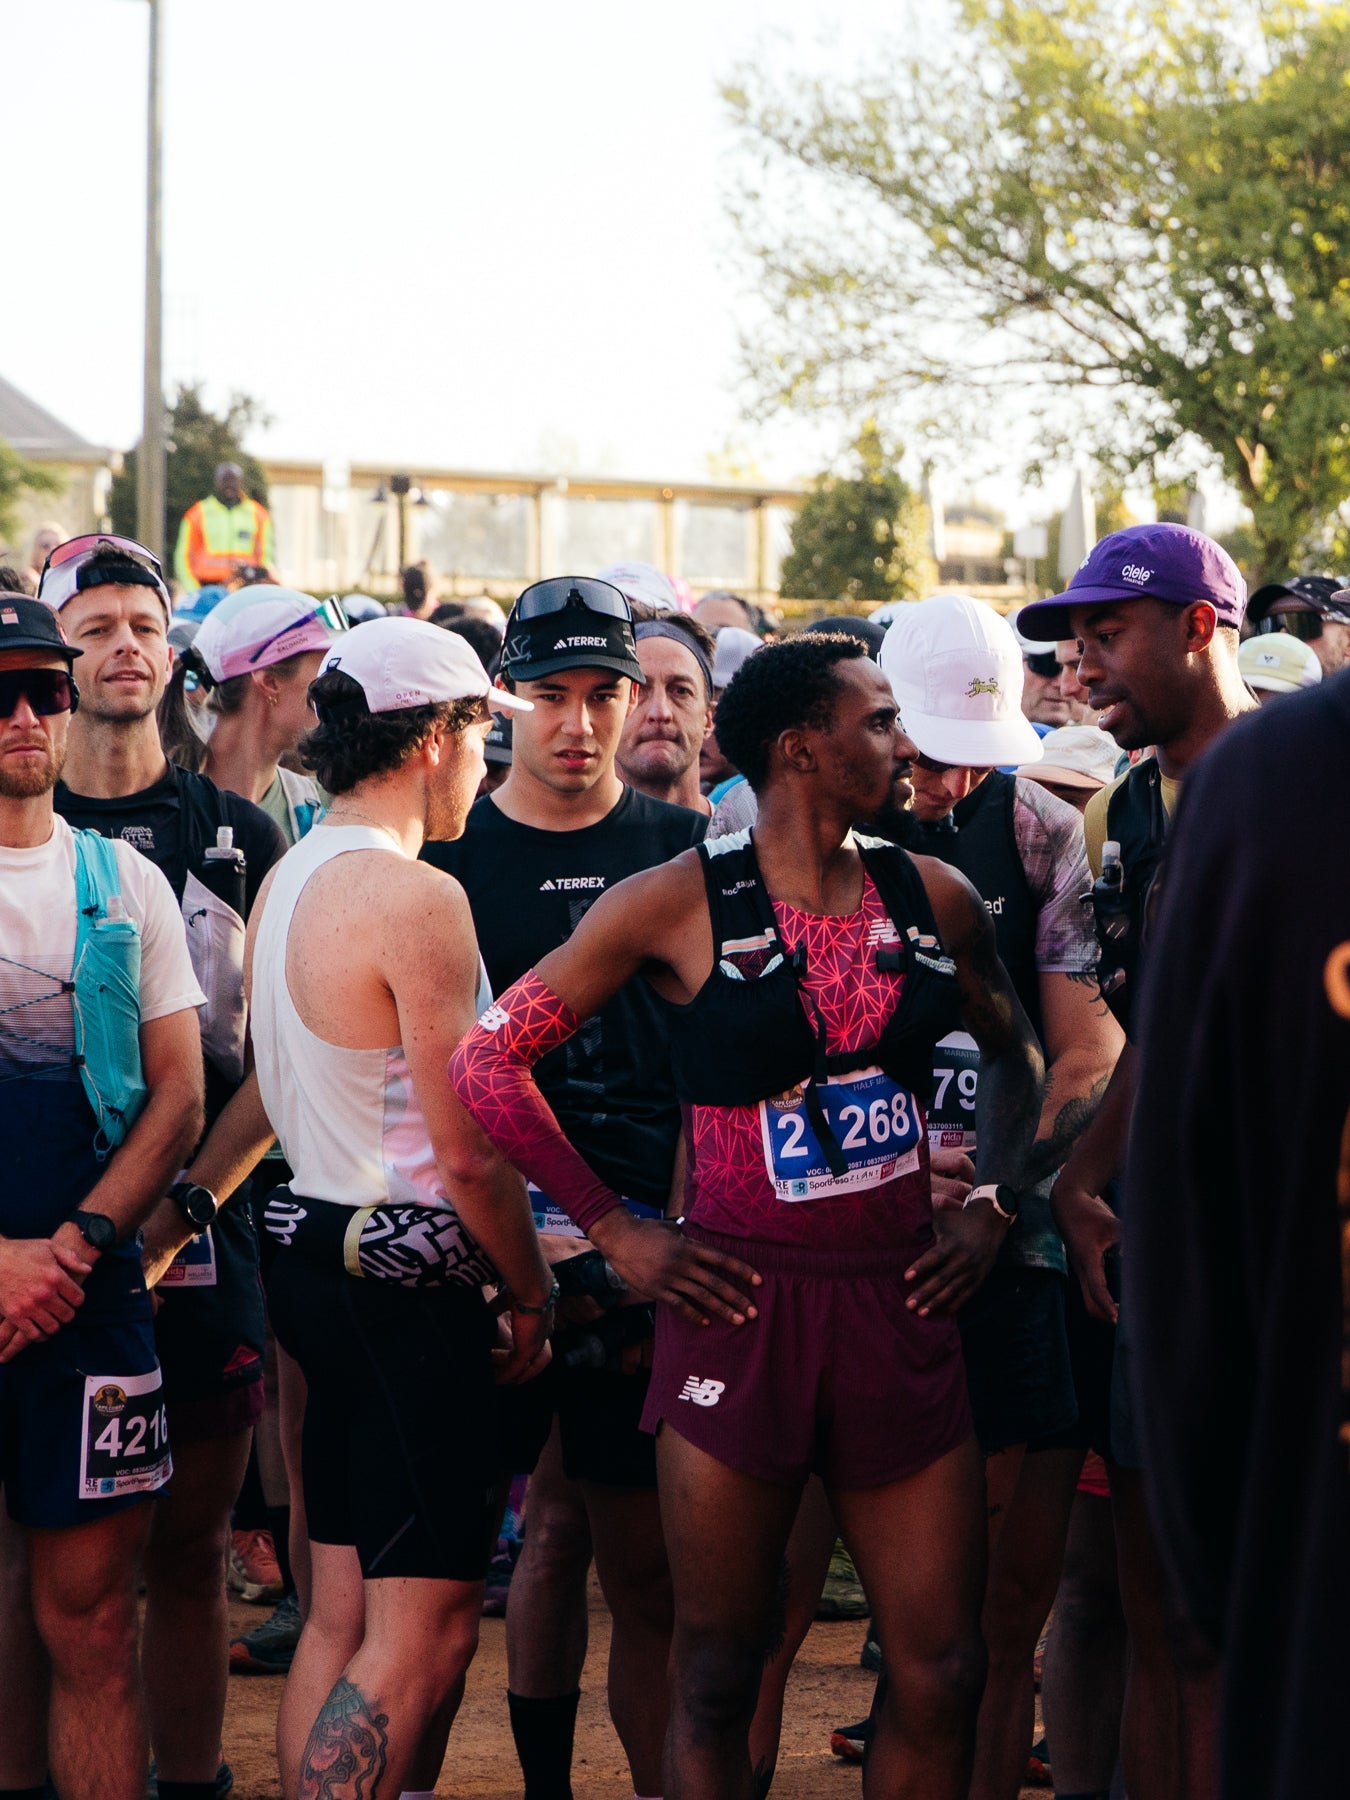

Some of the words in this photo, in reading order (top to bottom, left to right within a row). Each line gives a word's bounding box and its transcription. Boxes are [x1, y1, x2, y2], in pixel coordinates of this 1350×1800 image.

[566, 635, 608, 648] TERREX
[396, 690, 421, 700] OPEN
[555, 877, 606, 890] TERREX
[944, 1049, 981, 1059] MARATHO
[853, 1079, 874, 1091] HALF
[777, 1092, 911, 1159] 2268
[806, 1168, 825, 1176] VOC:
[809, 1176, 849, 1190] SportPesa
[546, 1217, 577, 1227] SportPe
[678, 1375, 726, 1407] NB
[94, 1402, 168, 1458] 4216
